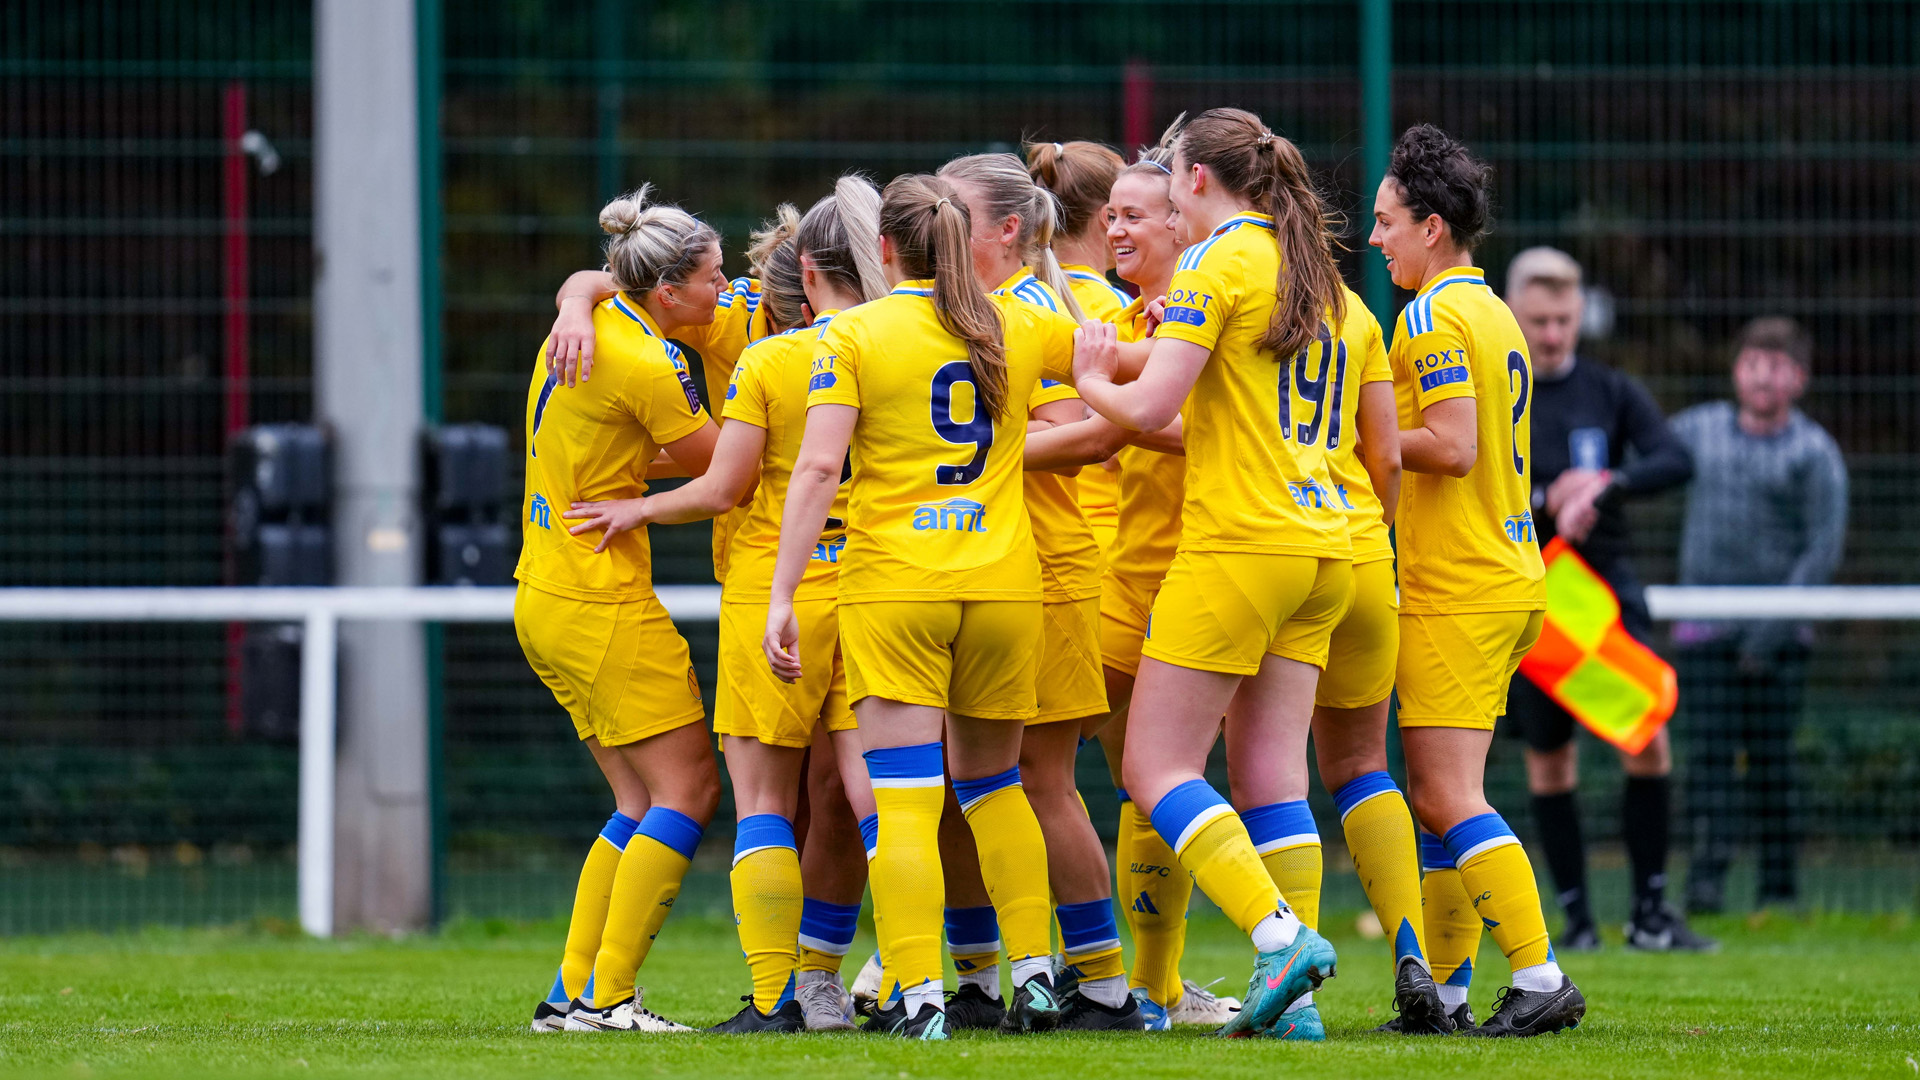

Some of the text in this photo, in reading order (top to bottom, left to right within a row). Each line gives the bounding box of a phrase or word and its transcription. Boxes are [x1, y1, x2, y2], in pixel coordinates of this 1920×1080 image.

[1165, 307, 1197, 323] LIFE
[1414, 349, 1465, 374] BOXT
[1426, 368, 1461, 388] LIFE
[930, 360, 995, 486] 9
[912, 505, 988, 533] amt
